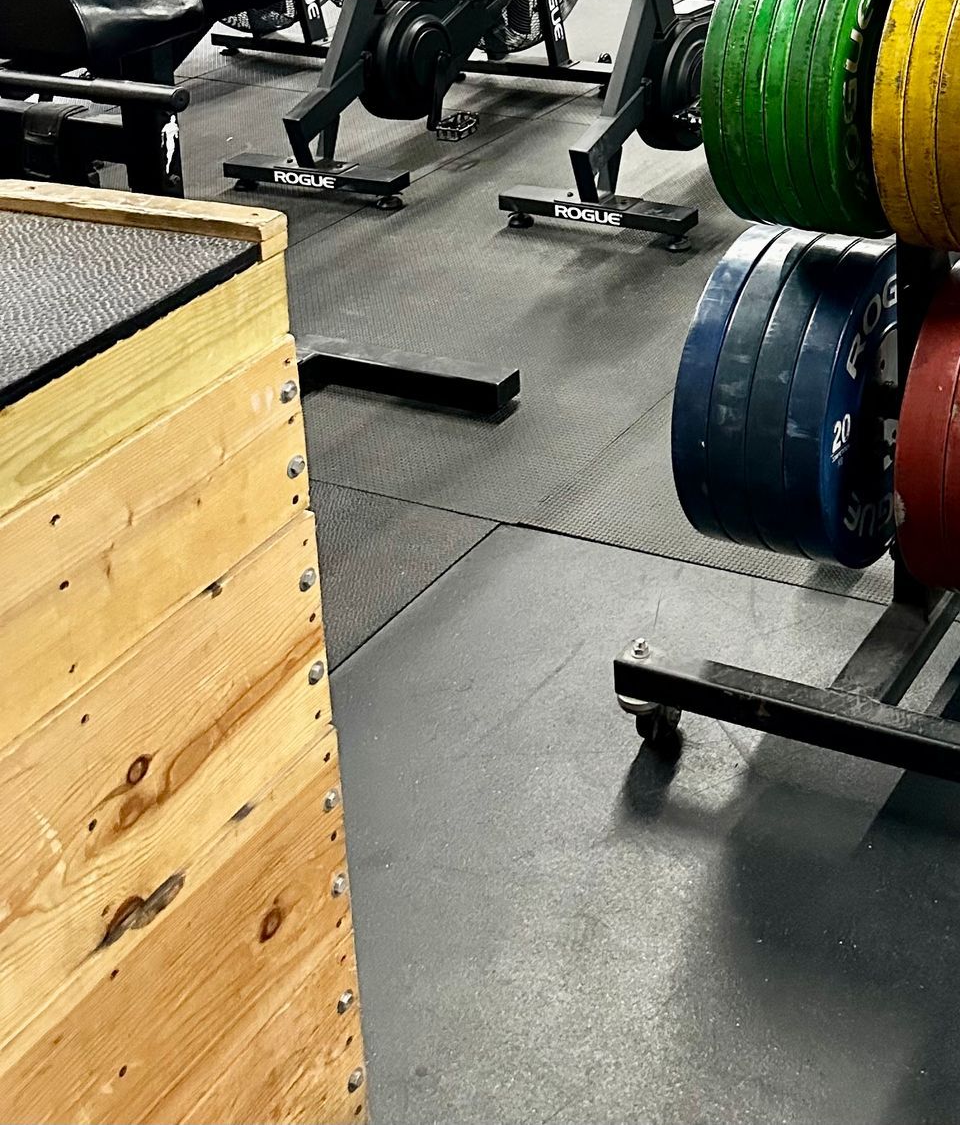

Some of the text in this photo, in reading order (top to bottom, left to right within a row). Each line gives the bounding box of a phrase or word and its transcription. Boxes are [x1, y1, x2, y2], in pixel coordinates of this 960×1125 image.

[274, 169, 336, 190] ROGUE
[554, 204, 623, 227] ROGUE
[831, 413, 851, 454] 20
